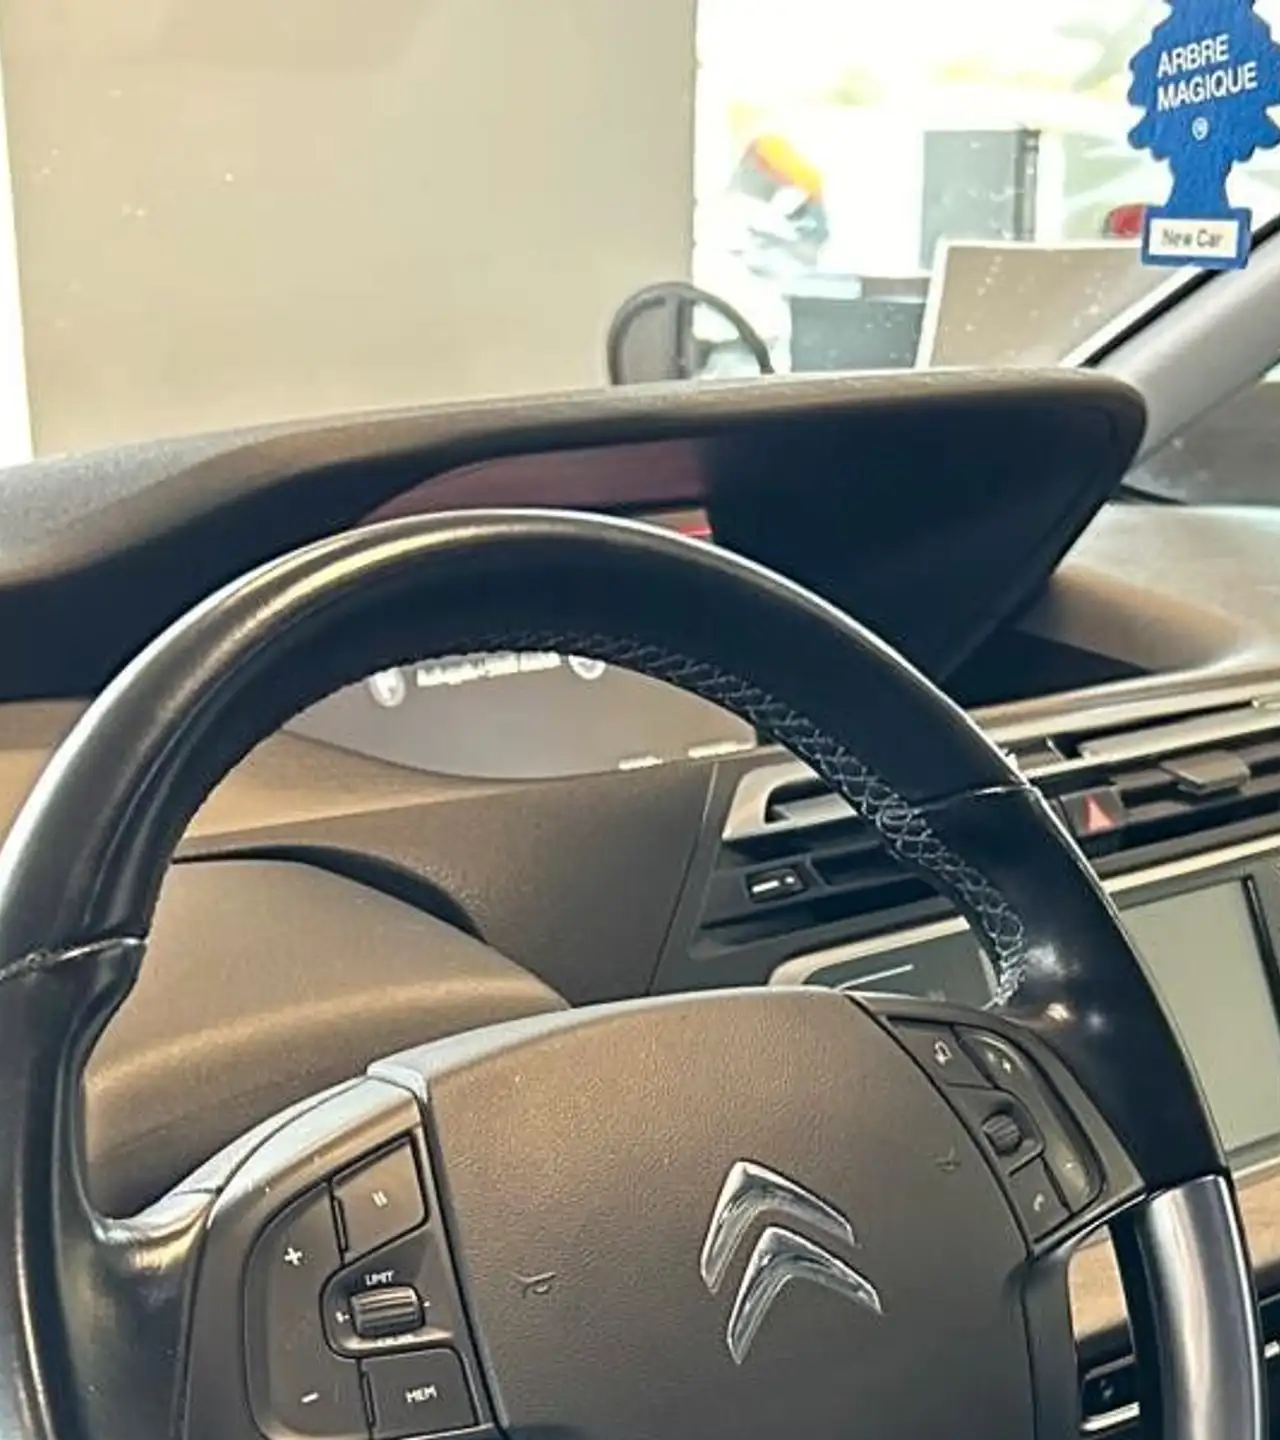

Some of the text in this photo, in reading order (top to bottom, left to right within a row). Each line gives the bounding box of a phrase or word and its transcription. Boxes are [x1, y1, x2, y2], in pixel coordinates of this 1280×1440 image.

[1156, 33, 1230, 79] ARBRE
[1156, 61, 1259, 112] MAGIQUE
[1161, 228, 1225, 248] New Car
[405, 1384, 438, 1403] MEM
